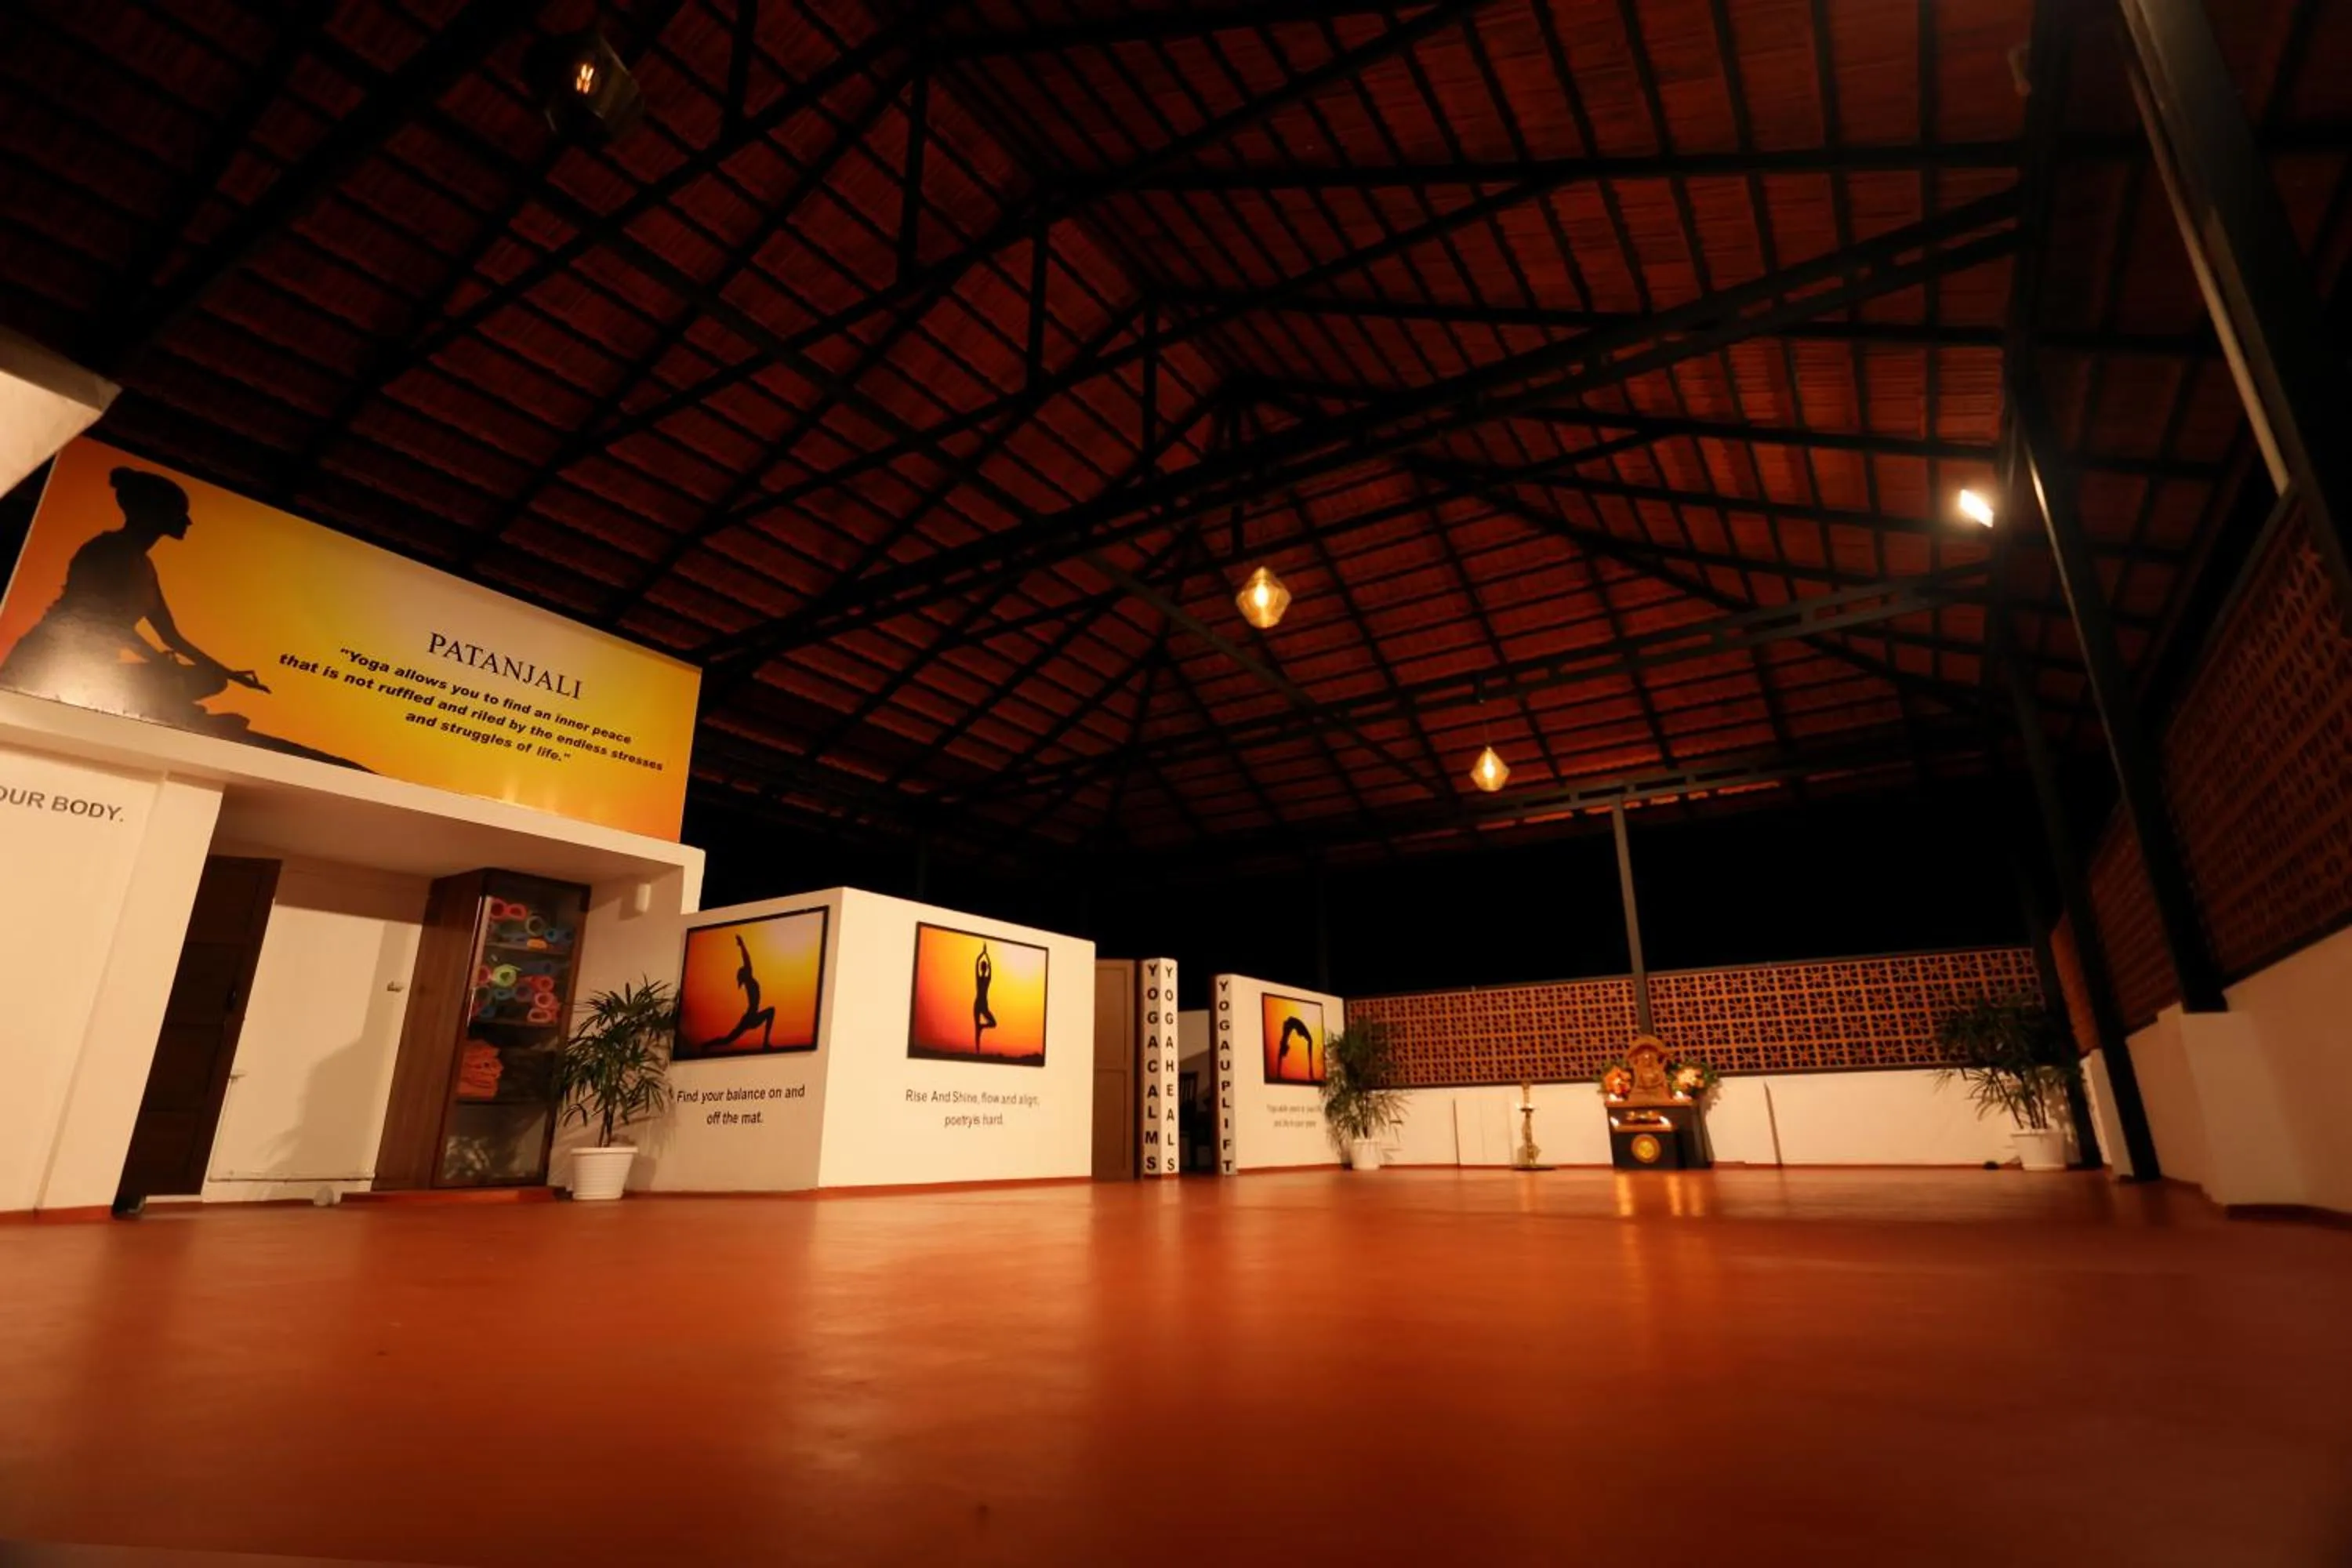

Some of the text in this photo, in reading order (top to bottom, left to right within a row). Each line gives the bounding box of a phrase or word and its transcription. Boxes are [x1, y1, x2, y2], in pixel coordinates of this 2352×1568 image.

[426, 632, 583, 701] PATANJALI
[278, 653, 663, 771] that is not ruffled and riled by the endless stresses
[394, 667, 447, 689] allows
[451, 684, 479, 699] you
[484, 692, 499, 705] to
[503, 699, 532, 714] find
[534, 709, 551, 720] an
[554, 713, 590, 731] inner
[591, 727, 632, 744] peace
[405, 712, 437, 727] and
[440, 721, 511, 747] struggles
[517, 742, 532, 753] of
[51, 796, 124, 822] BODY.
[677, 1084, 805, 1105] Find your balance on and
[905, 1088, 927, 1102] Rise
[931, 1091, 951, 1103] And
[981, 1091, 1000, 1104] flow
[1000, 1093, 1018, 1105] and
[706, 1111, 764, 1124] off the mat.
